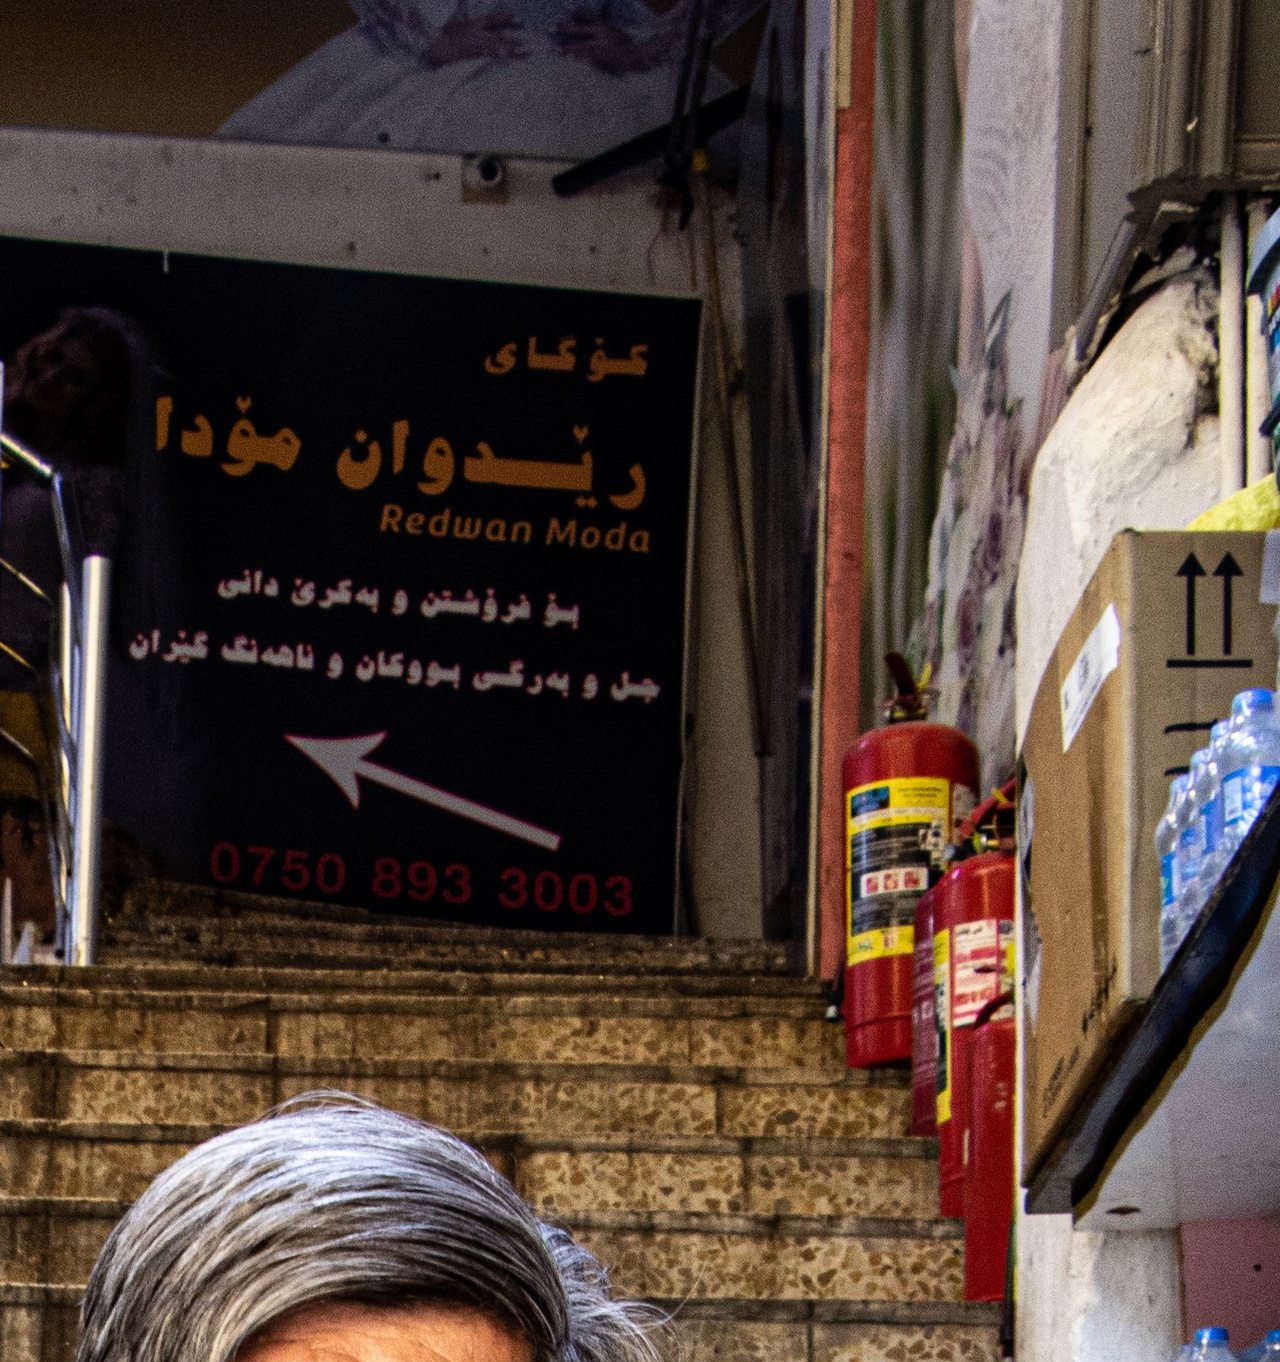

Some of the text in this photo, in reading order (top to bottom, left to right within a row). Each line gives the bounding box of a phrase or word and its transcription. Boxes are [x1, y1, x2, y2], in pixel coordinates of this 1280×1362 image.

[379, 503, 650, 554] Redwan Moda
[391, 589, 409, 616] و
[326, 652, 344, 679] و
[582, 673, 599, 700] و
[210, 841, 633, 917] 0750 893 3003
